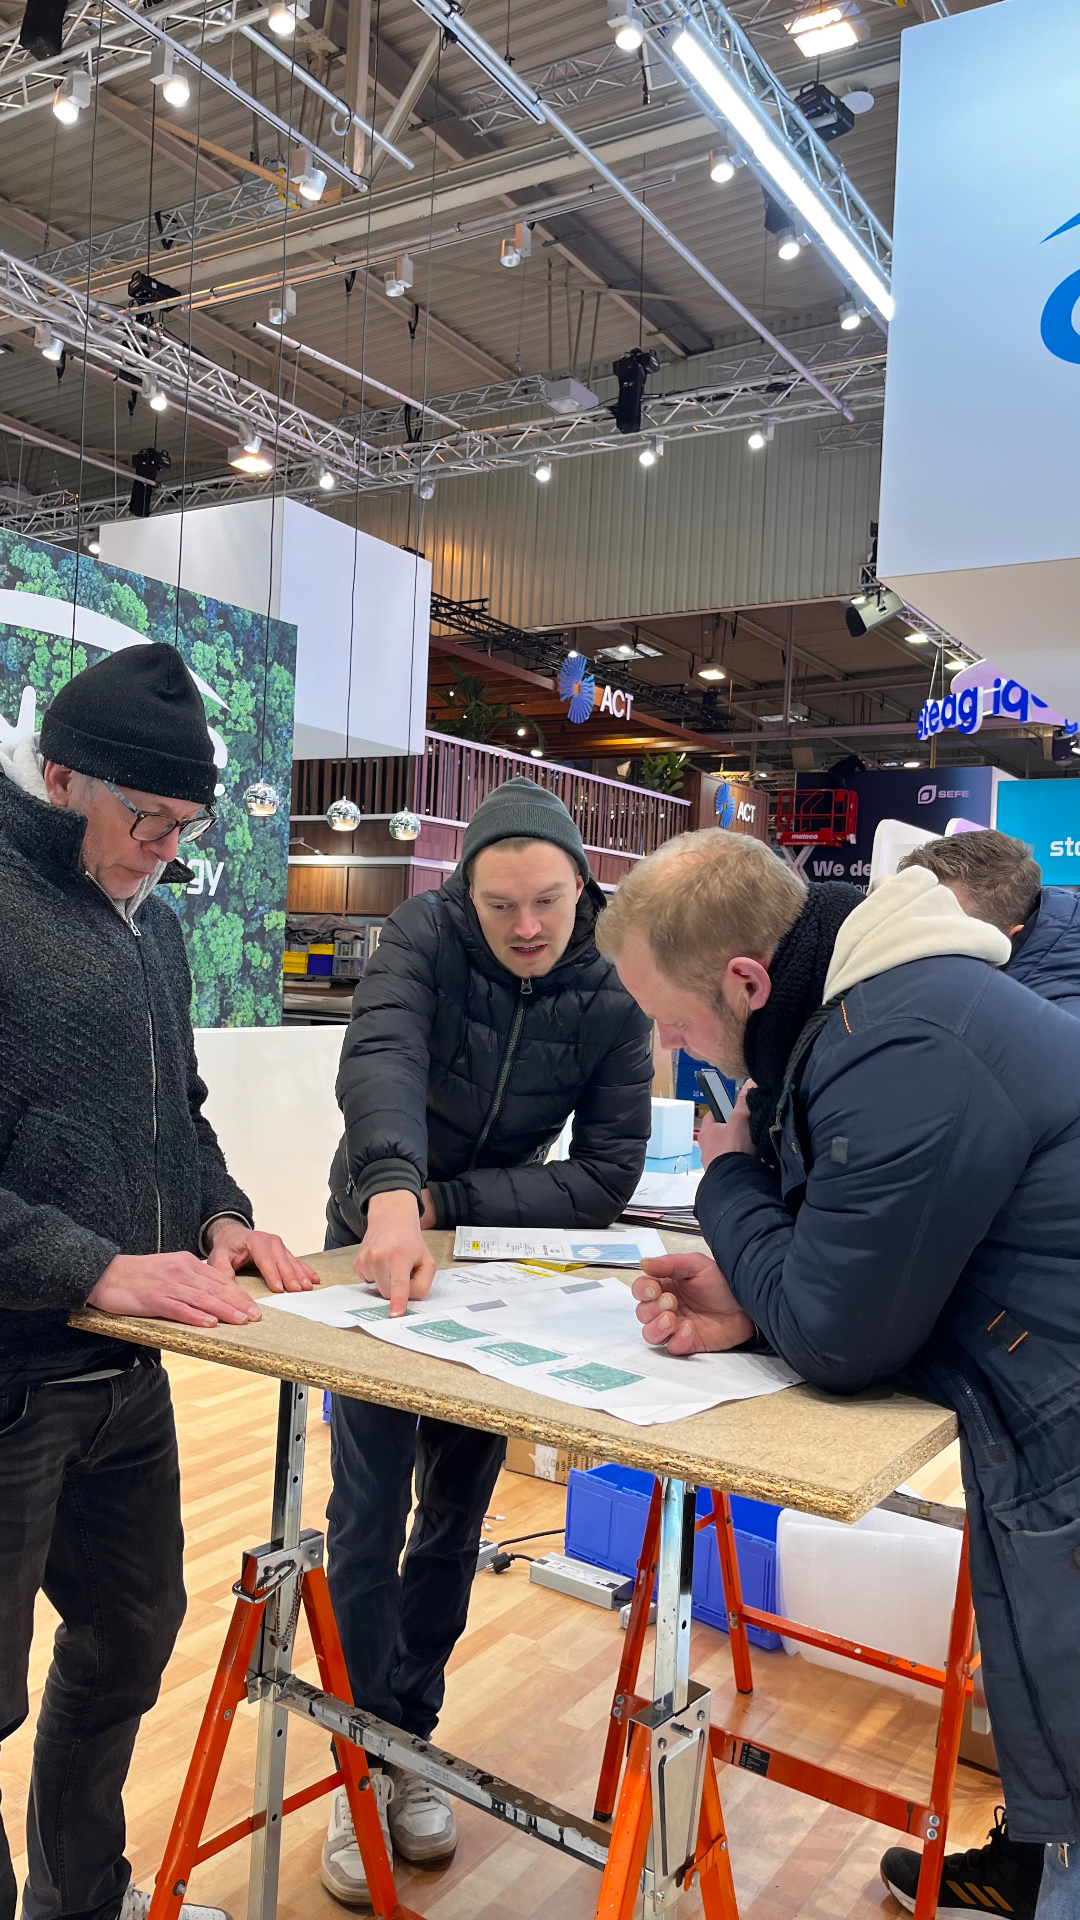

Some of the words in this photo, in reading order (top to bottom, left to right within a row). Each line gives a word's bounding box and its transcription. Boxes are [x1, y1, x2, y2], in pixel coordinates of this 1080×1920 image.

[600, 685, 634, 721] ACT
[917, 686, 981, 740] steag
[938, 790, 969, 799] SEFE
[737, 801, 756, 823] ACT
[176, 857, 225, 897] gy
[813, 860, 845, 877] We
